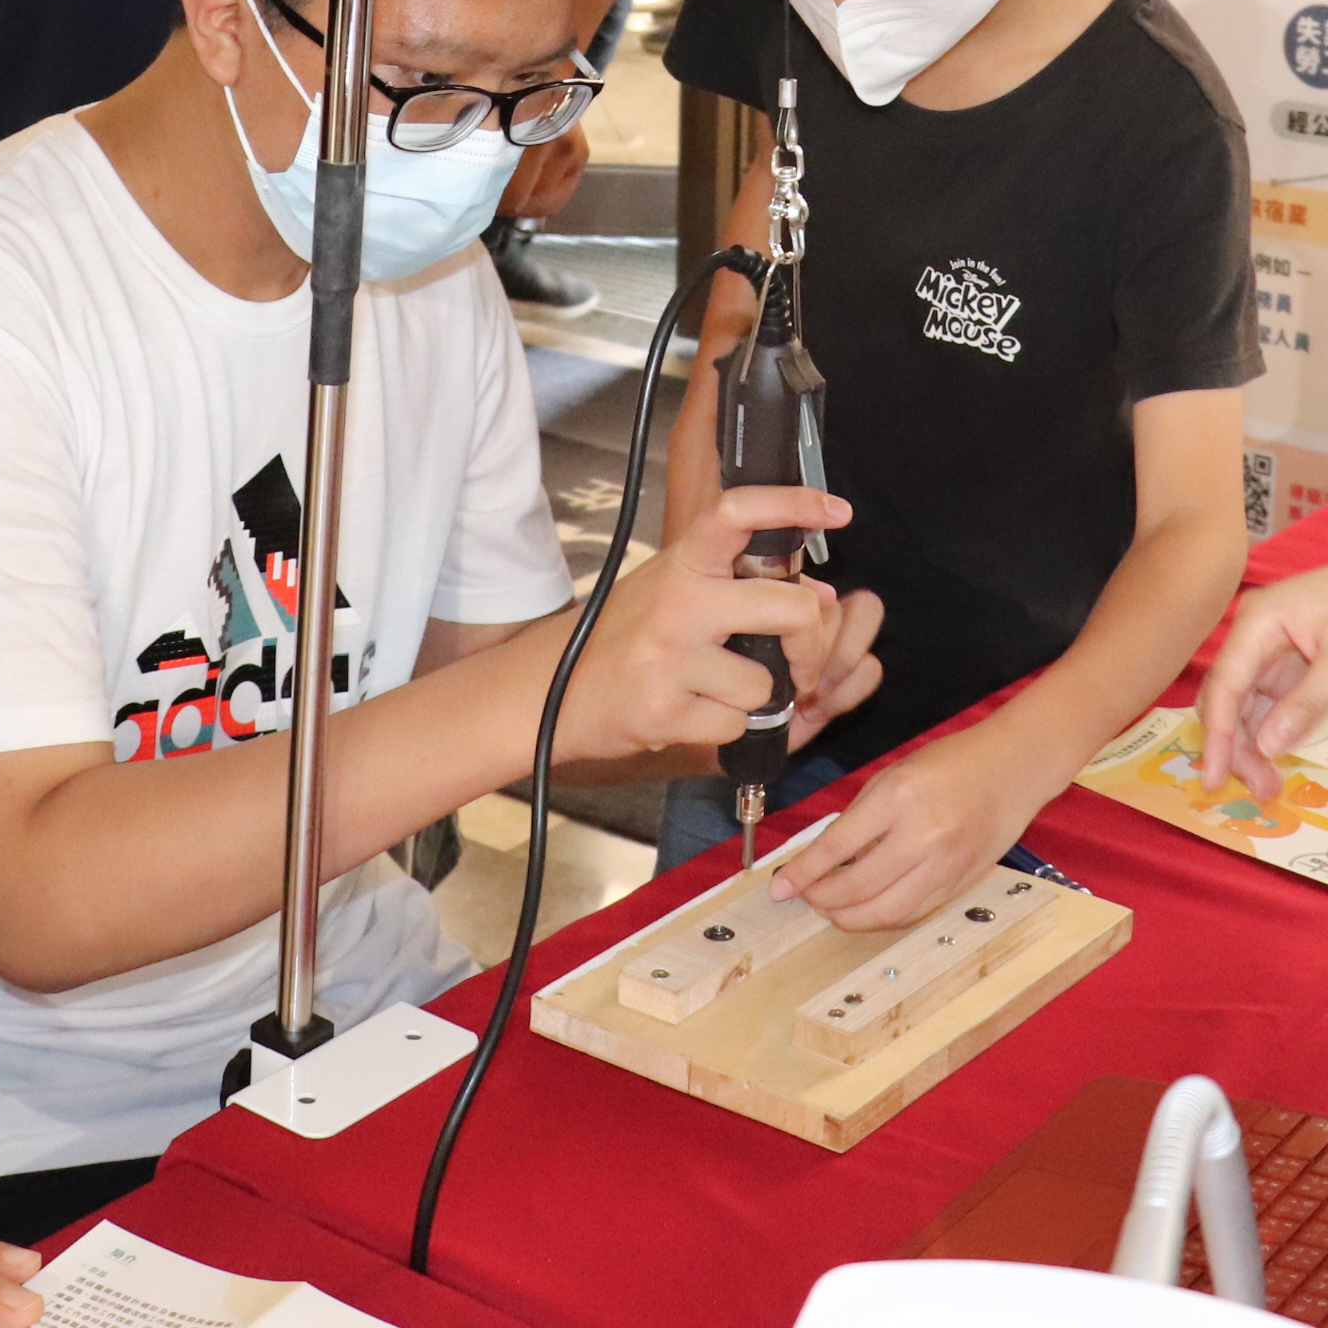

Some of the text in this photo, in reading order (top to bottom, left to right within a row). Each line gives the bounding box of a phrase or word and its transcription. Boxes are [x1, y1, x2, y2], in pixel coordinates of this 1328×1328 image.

[949, 257, 1007, 287] Join in the fun!
[962, 268, 990, 289] Disney
